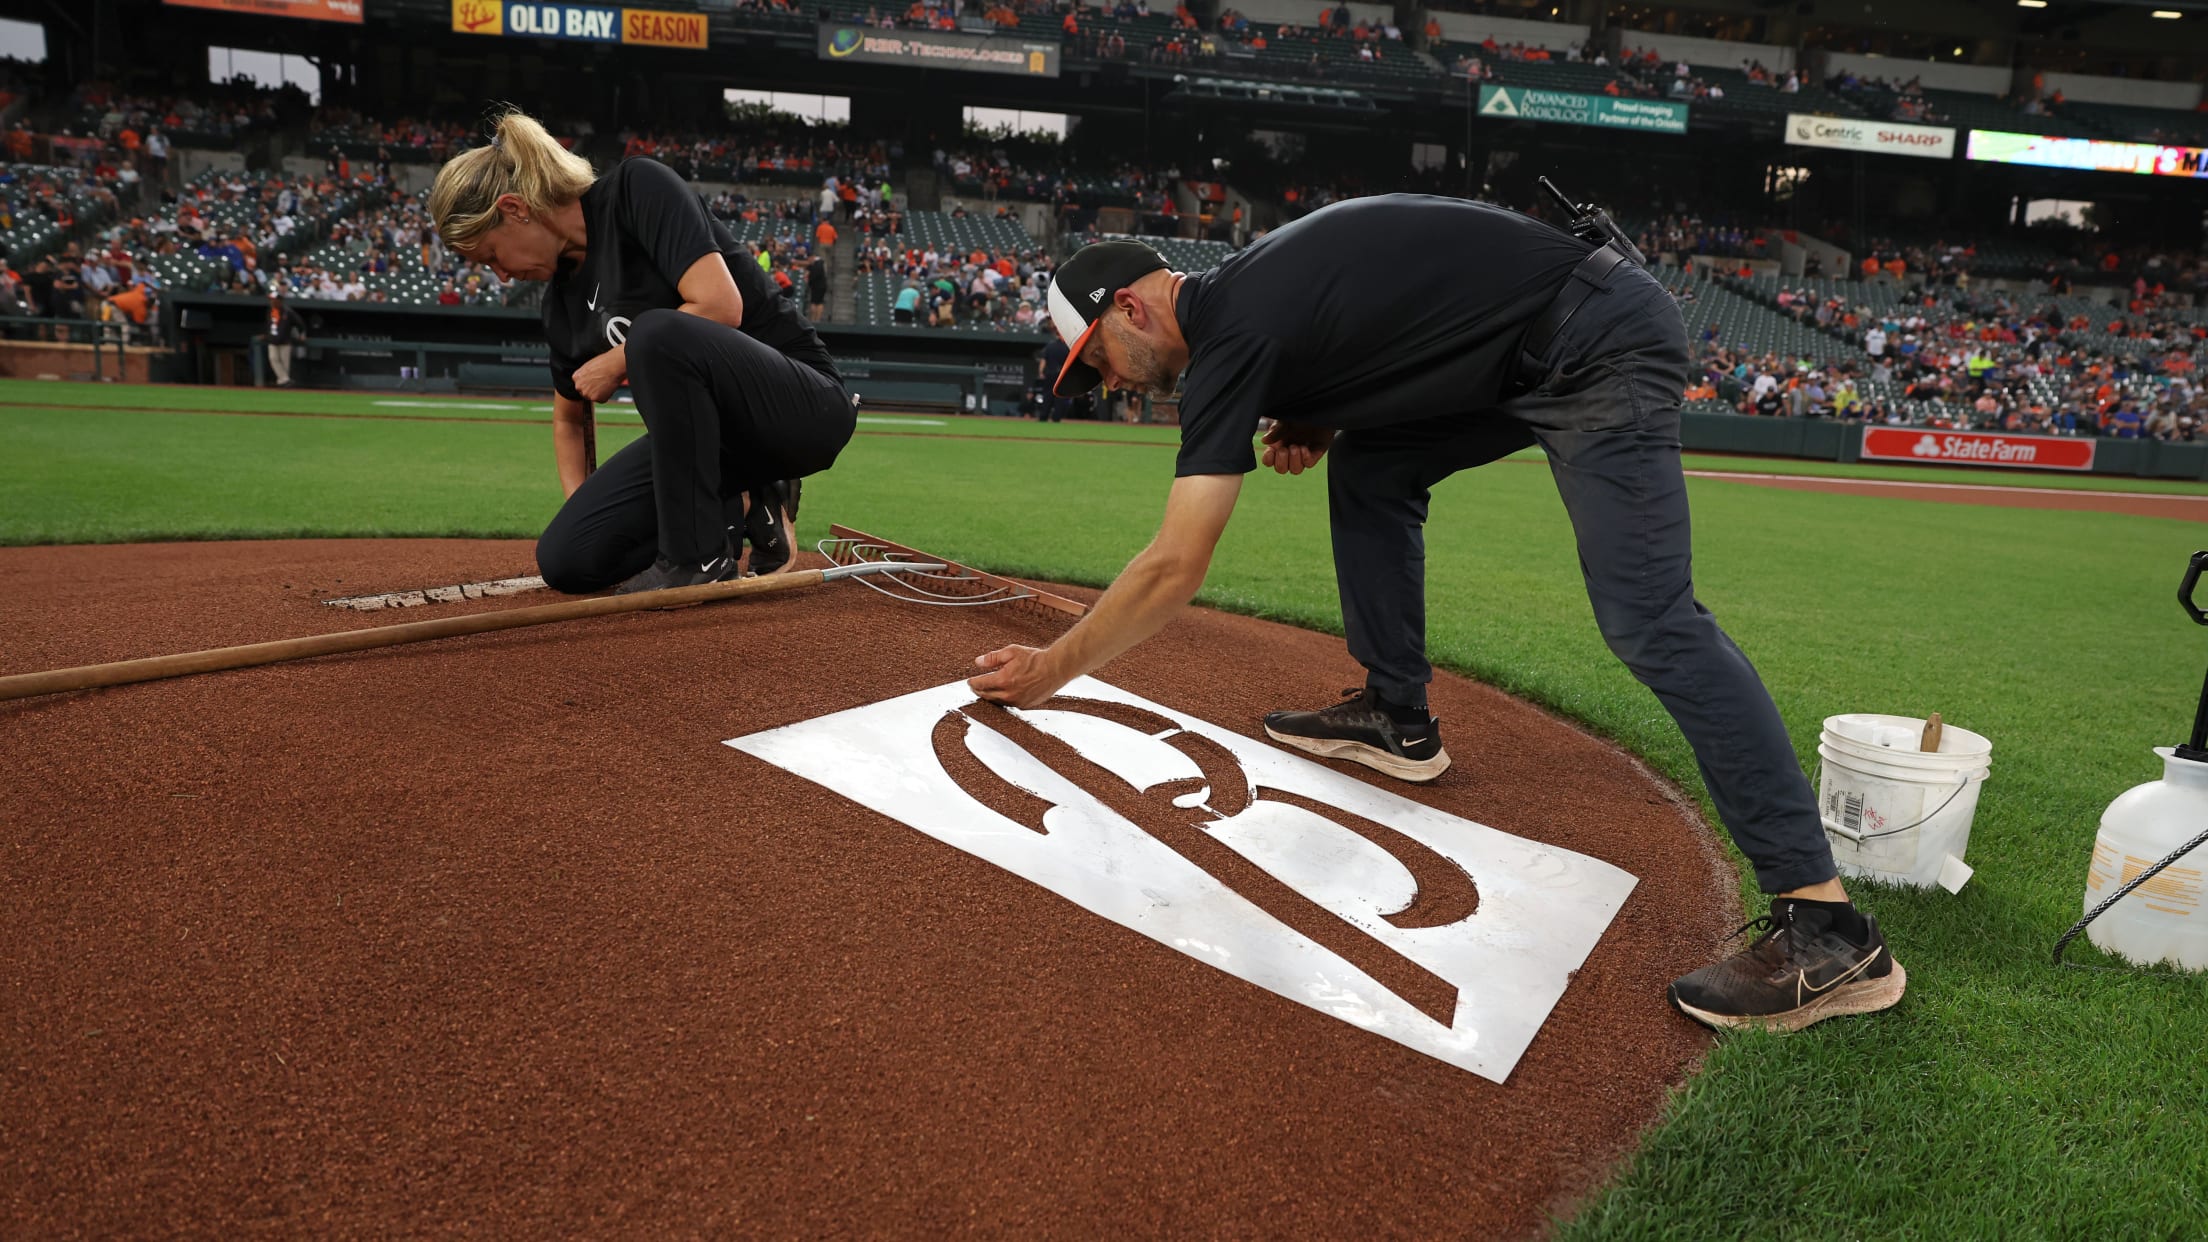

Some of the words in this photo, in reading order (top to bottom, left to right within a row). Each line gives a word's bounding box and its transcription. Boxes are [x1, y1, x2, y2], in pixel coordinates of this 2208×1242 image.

[509, 4, 560, 35] OLD
[566, 8, 615, 39] BAY
[629, 13, 701, 43] SEASON
[1520, 89, 1589, 109] ADVANCED
[1613, 100, 1639, 112] Proud
[1519, 102, 1590, 122] RADIOLOGY
[1598, 111, 1630, 124] Partner
[1630, 113, 1640, 125] of
[1641, 114, 1654, 126] the
[1655, 116, 1685, 130] Orioles
[1814, 123, 1863, 141] Centric
[1877, 131, 1942, 146] SHARP
